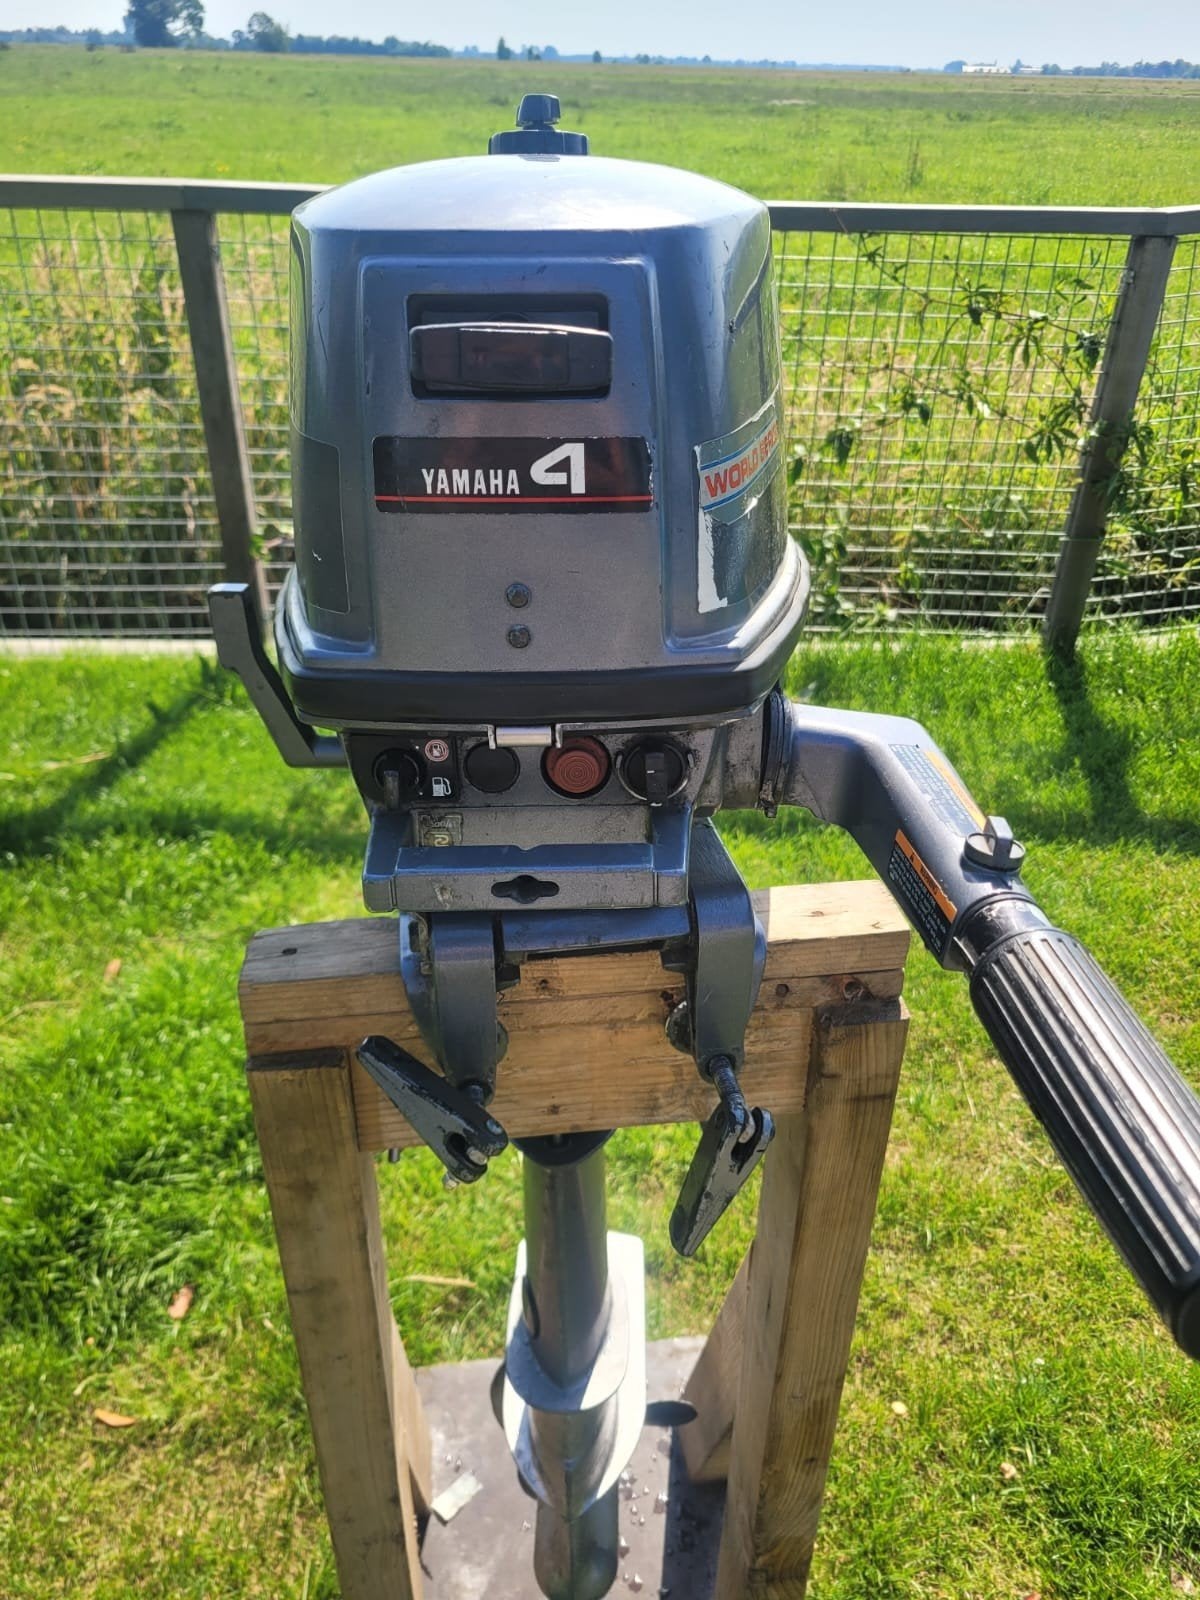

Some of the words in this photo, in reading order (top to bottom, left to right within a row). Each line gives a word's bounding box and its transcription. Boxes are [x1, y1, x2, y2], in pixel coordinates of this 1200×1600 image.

[421, 468, 520, 495] YAMAHA
[530, 442, 586, 494] 4
[705, 448, 759, 498] WORLD
